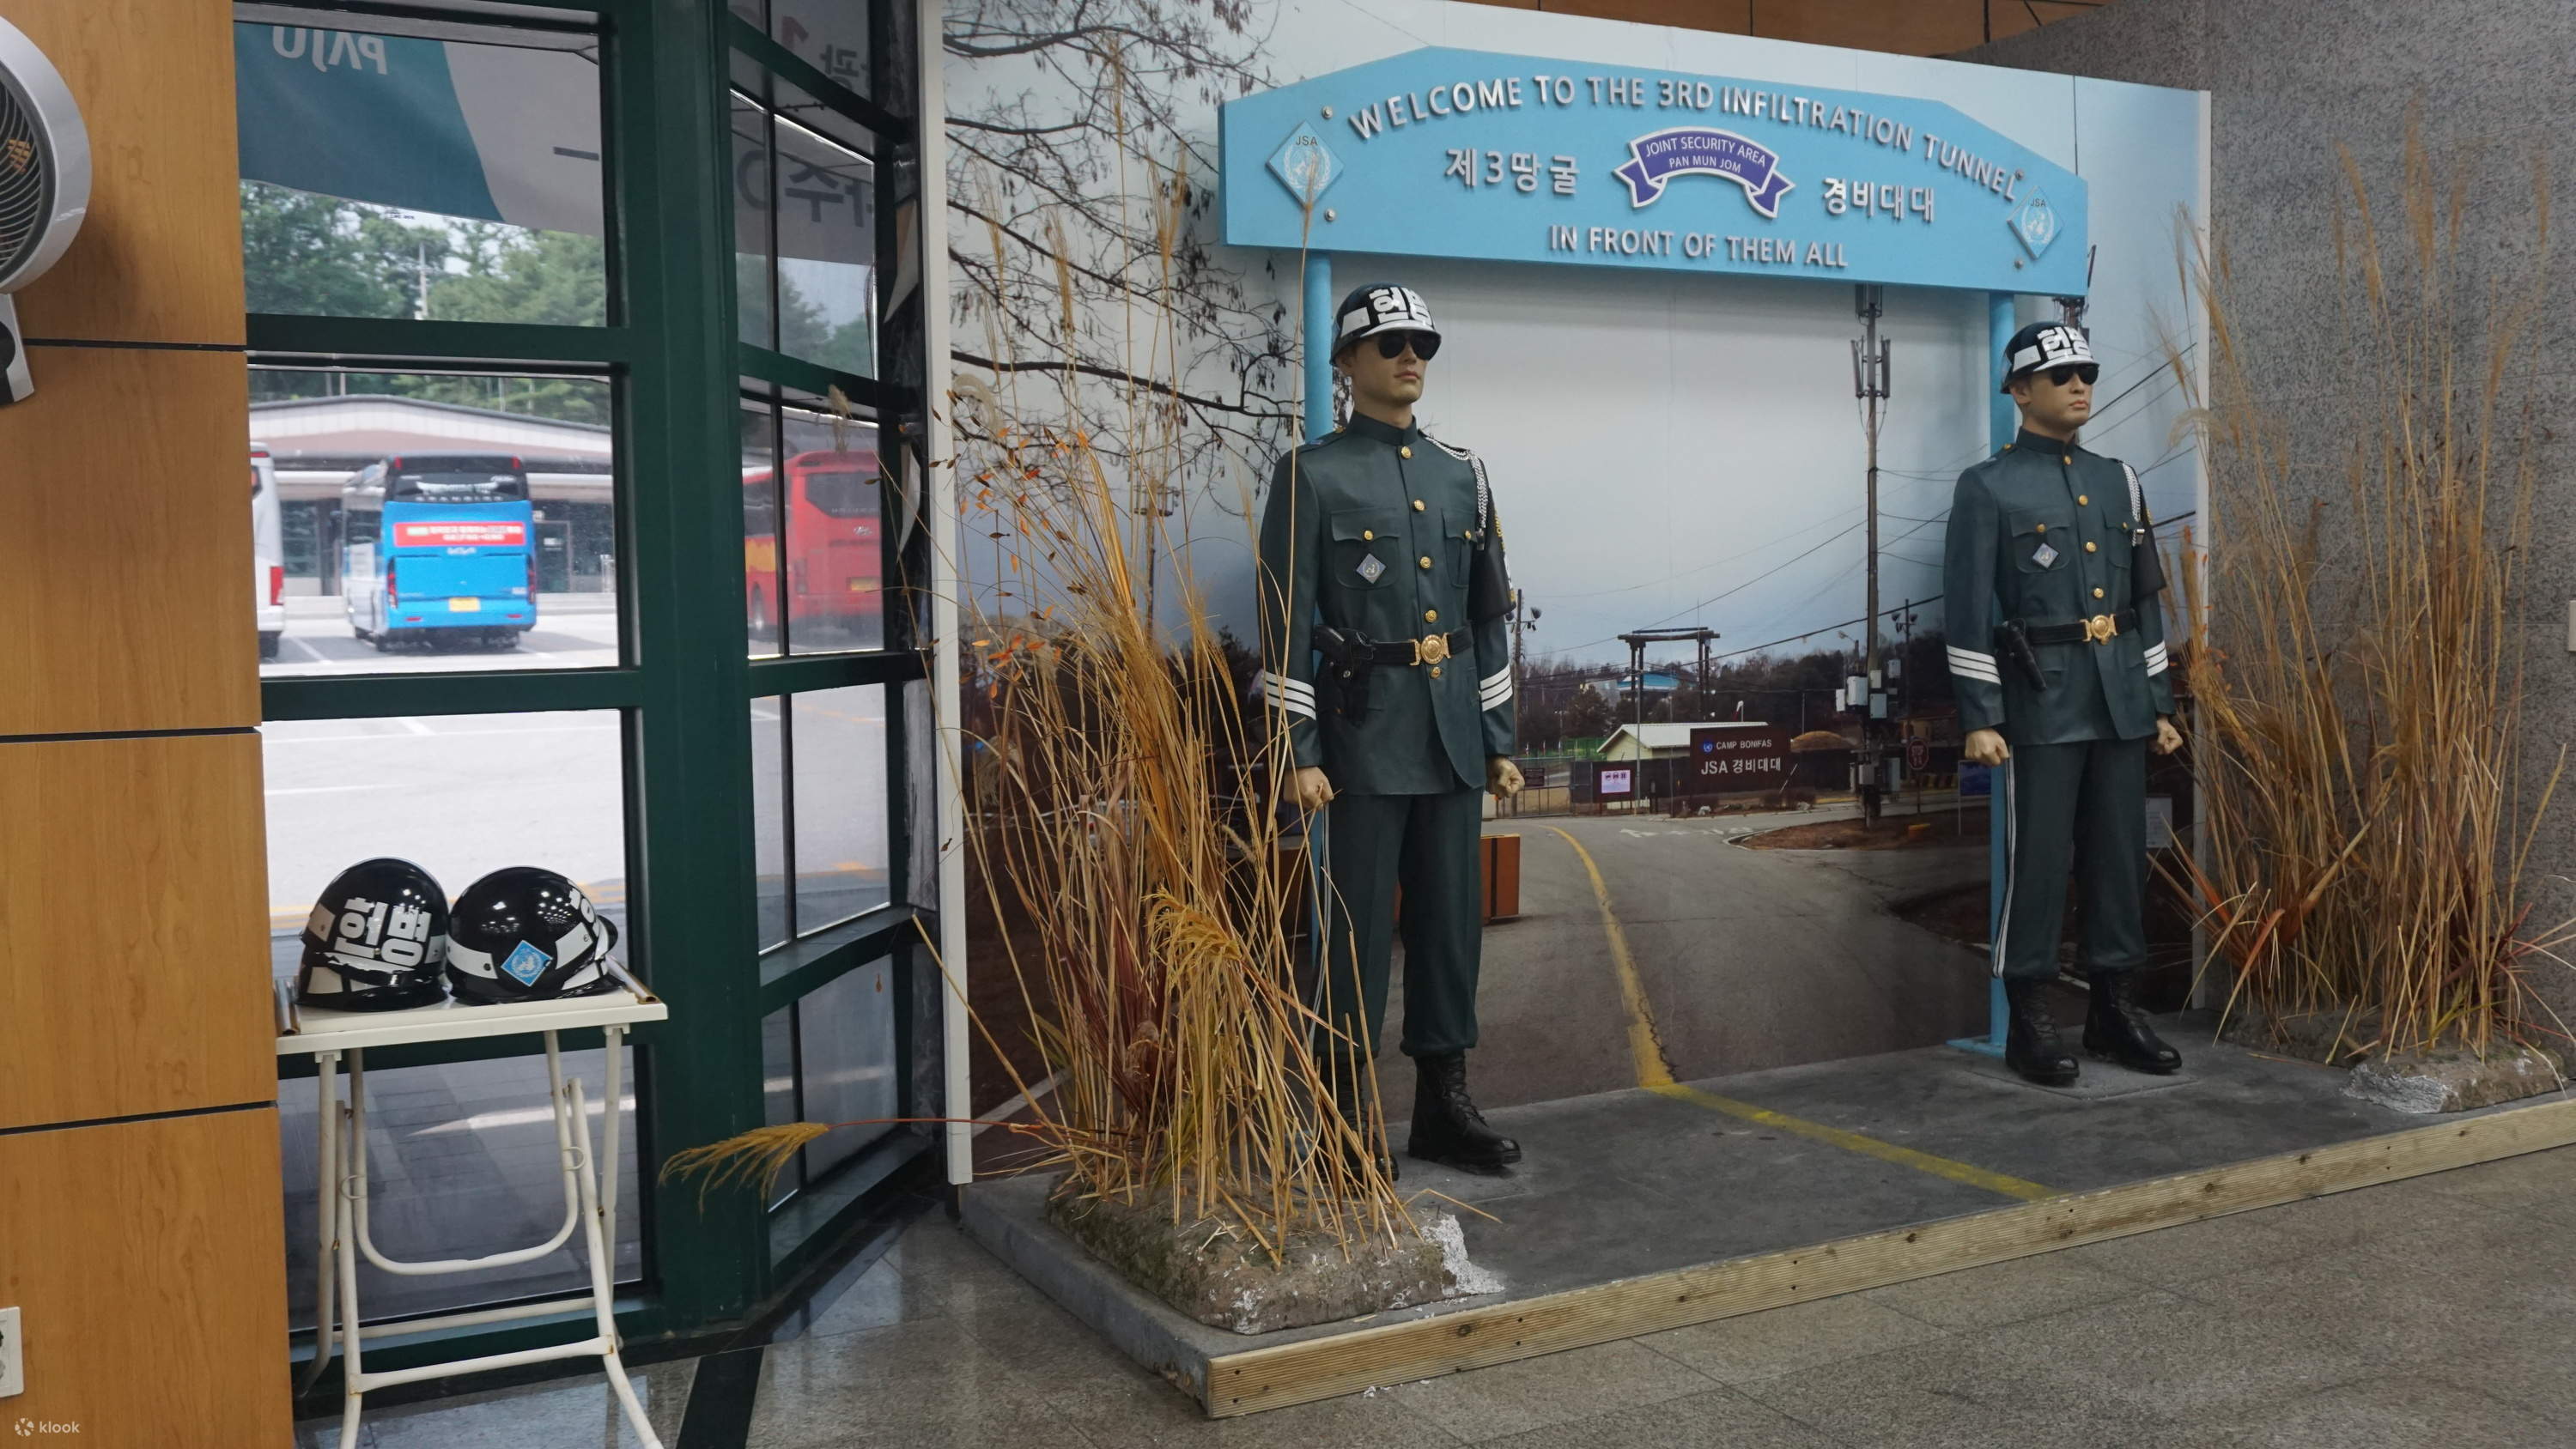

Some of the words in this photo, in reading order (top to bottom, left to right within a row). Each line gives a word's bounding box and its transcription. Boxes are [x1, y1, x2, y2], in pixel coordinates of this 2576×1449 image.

[1296, 136, 1318, 146] JSA
[1349, 76, 1523, 139] WELCOME
[1534, 75, 1576, 105] TO
[1587, 76, 1645, 106] THE
[1657, 79, 1714, 109] 3RD
[1721, 86, 1913, 151] INFILTRATION
[1923, 134, 2016, 202] TUNNEL
[1645, 137, 1679, 158] JOINT
[1680, 136, 1735, 154] SECURITY
[1737, 145, 1766, 168] AREA
[1668, 155, 1690, 169] PAN
[1692, 155, 1716, 167] MUN
[1719, 157, 1742, 173] JOM
[1824, 177, 1934, 222] 경비대대
[2031, 198, 2046, 207] JSA
[1549, 224, 1577, 252] IN
[1589, 227, 1674, 256] FRONT
[1684, 232, 1717, 258] OF
[1726, 235, 1795, 263] THEM
[1806, 241, 1849, 267] ALL
[1716, 741, 1737, 750] CAMP
[1740, 739, 1772, 749] BONIFAS
[1701, 760, 1728, 775] JSA
[1733, 756, 1782, 773] 경비대대
[333, 897, 432, 967] 헌병
